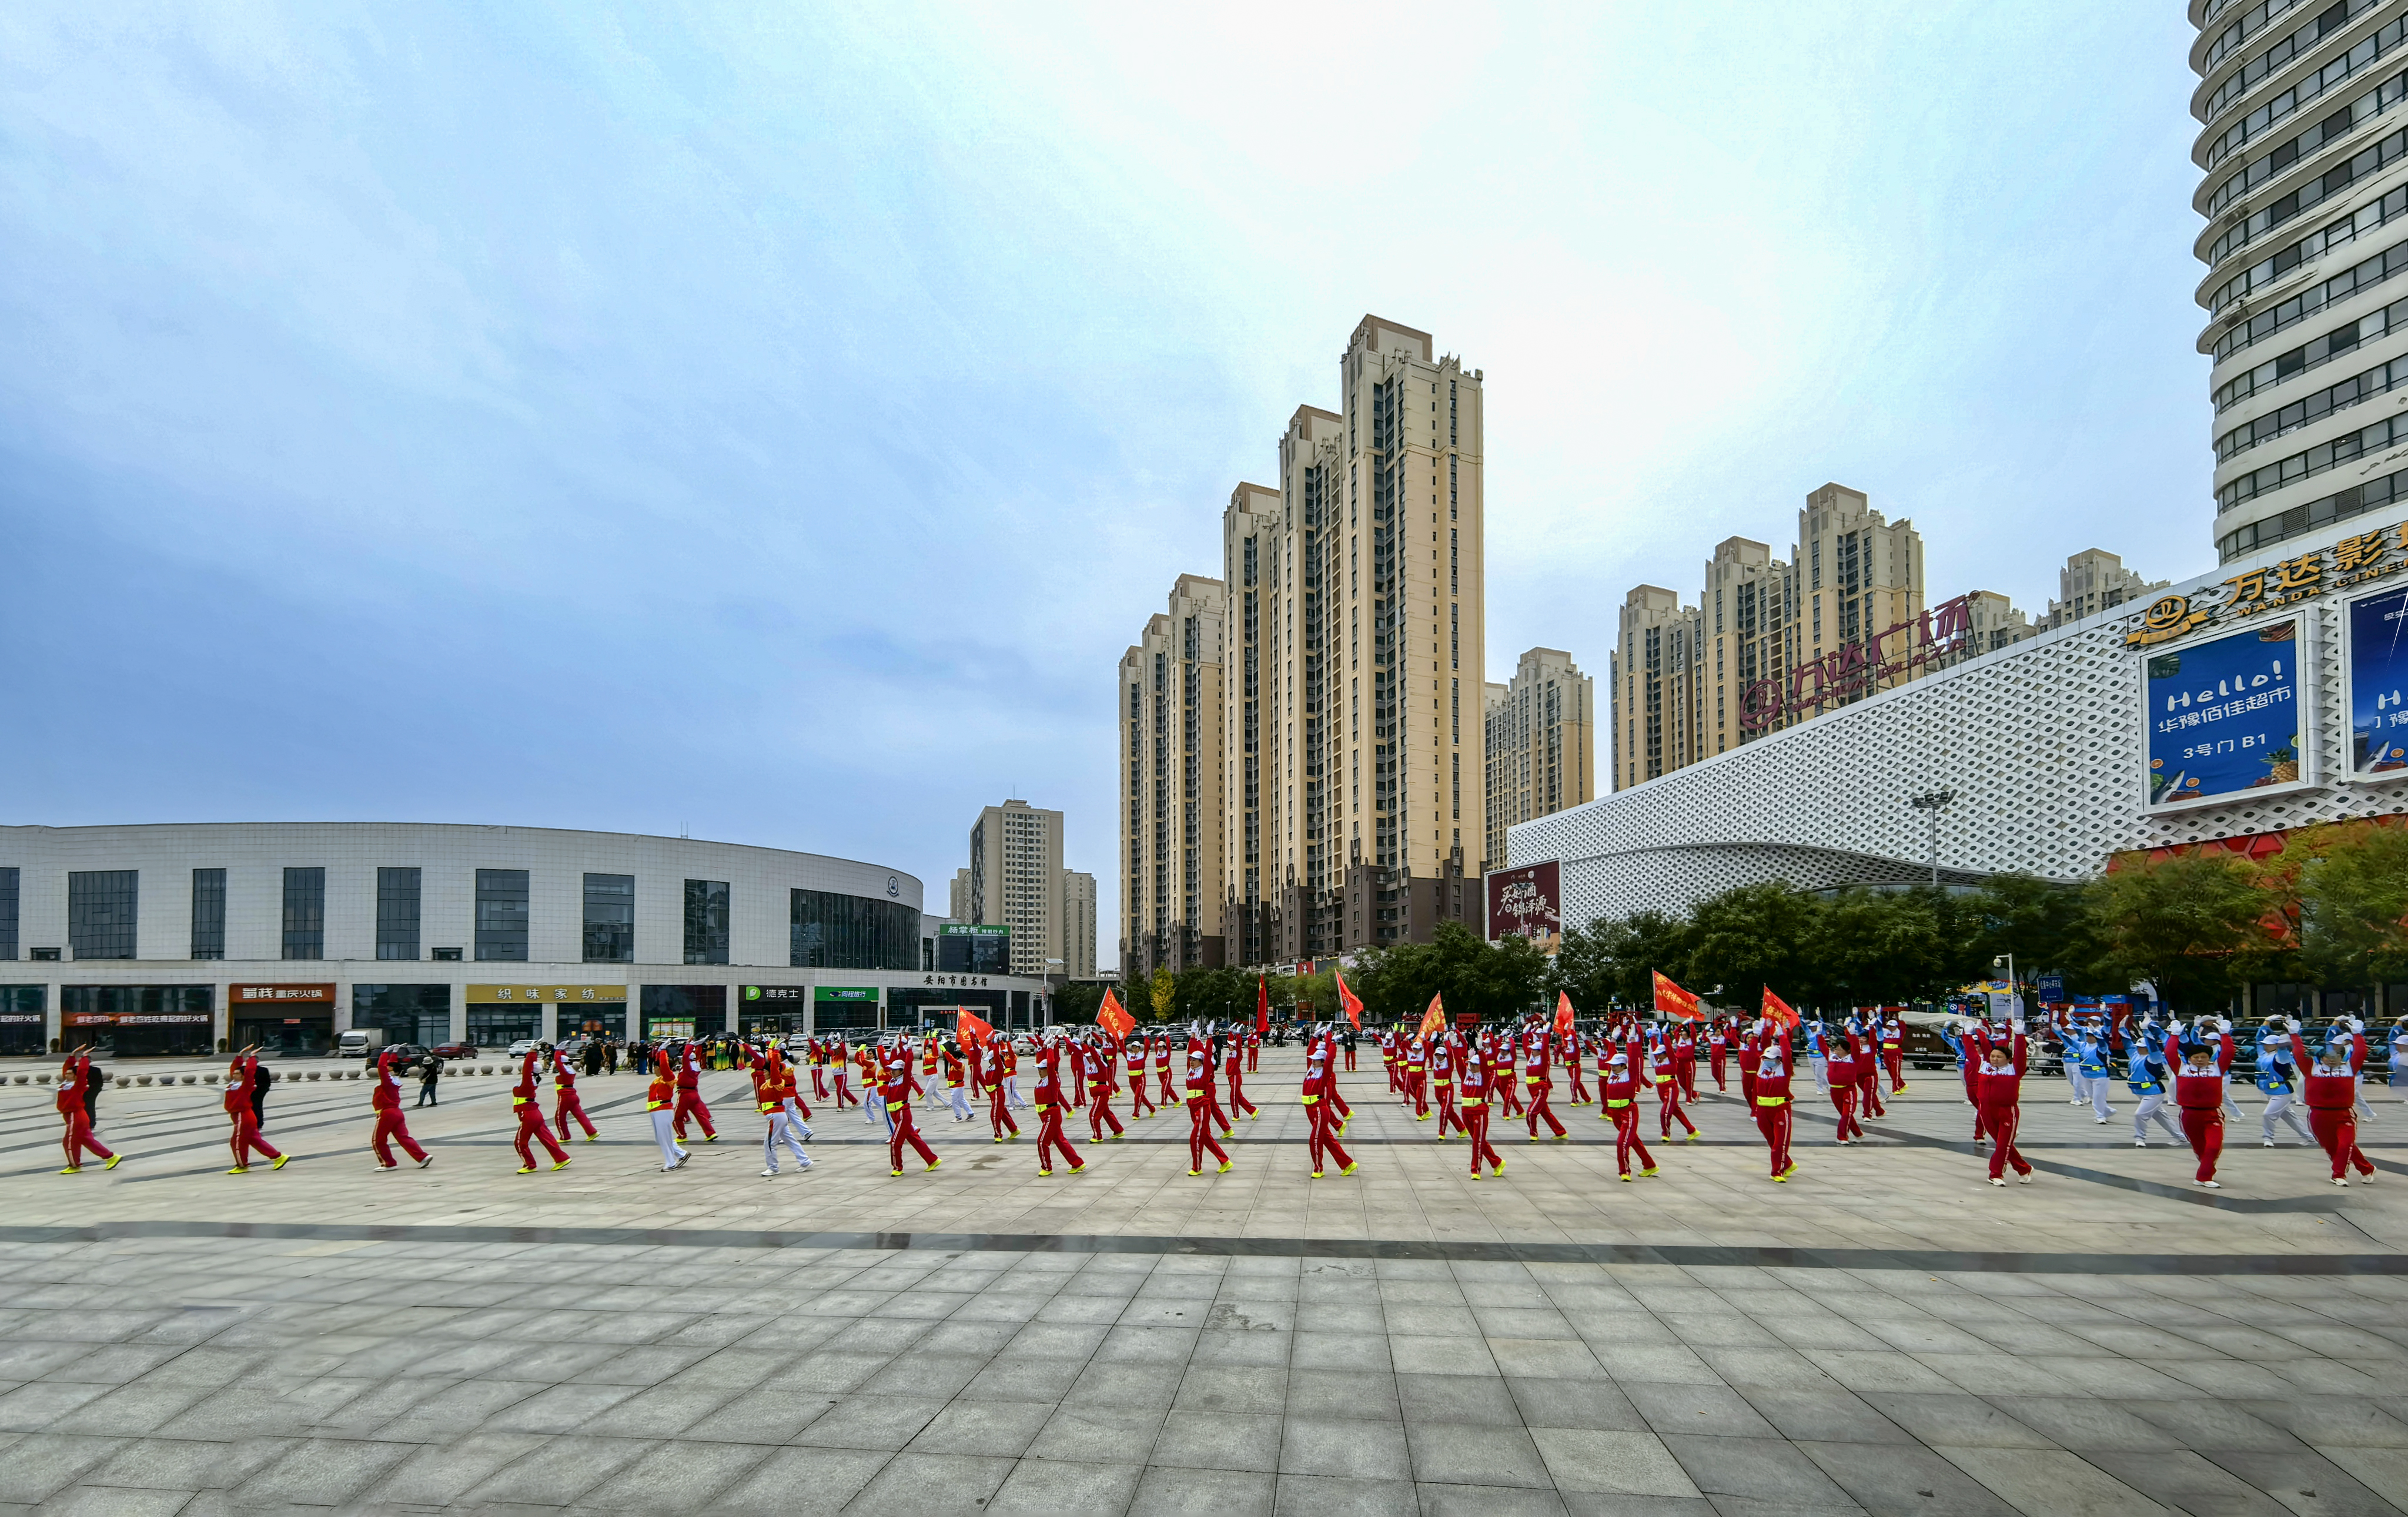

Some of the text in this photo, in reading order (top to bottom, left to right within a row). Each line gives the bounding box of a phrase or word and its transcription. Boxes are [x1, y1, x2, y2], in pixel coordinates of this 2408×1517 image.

[2236, 559, 2408, 617] WANDA CINE
[1791, 594, 1969, 698] 万达广场
[2167, 659, 2284, 712] Hello!
[2158, 685, 2292, 733] 华豫佰佳超市
[2183, 733, 2266, 759] 3号门 B1
[497, 988, 595, 1000] 织味家纺
[765, 989, 799, 999] 德克士
[923, 975, 988, 987] 安阳市图书馆
[276, 990, 323, 999] 重庆火锅
